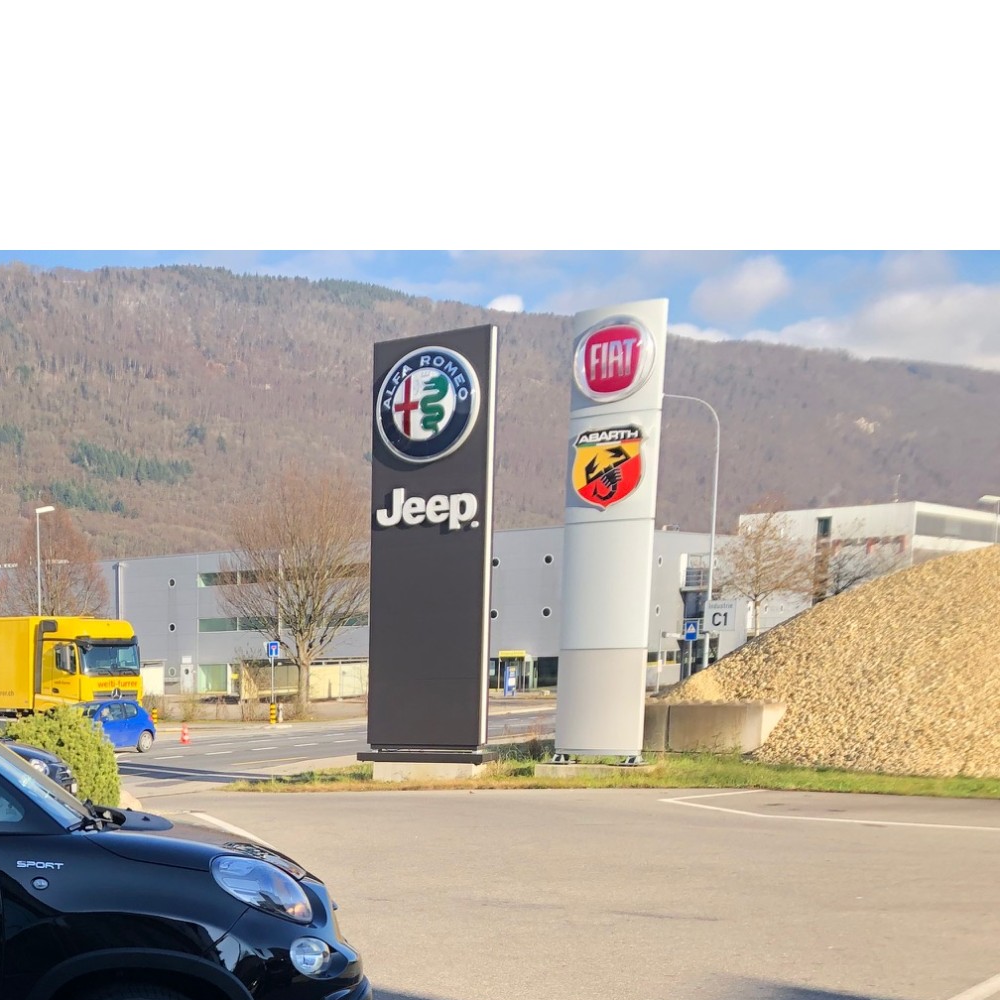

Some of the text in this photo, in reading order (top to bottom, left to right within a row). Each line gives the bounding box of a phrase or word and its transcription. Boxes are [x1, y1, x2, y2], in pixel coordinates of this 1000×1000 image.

[590, 337, 637, 380] FIAT
[383, 355, 469, 410] ALFA ROMEO
[578, 429, 639, 444] ABARTH
[711, 612, 729, 627] C1
[16, 860, 65, 870] SPORT
